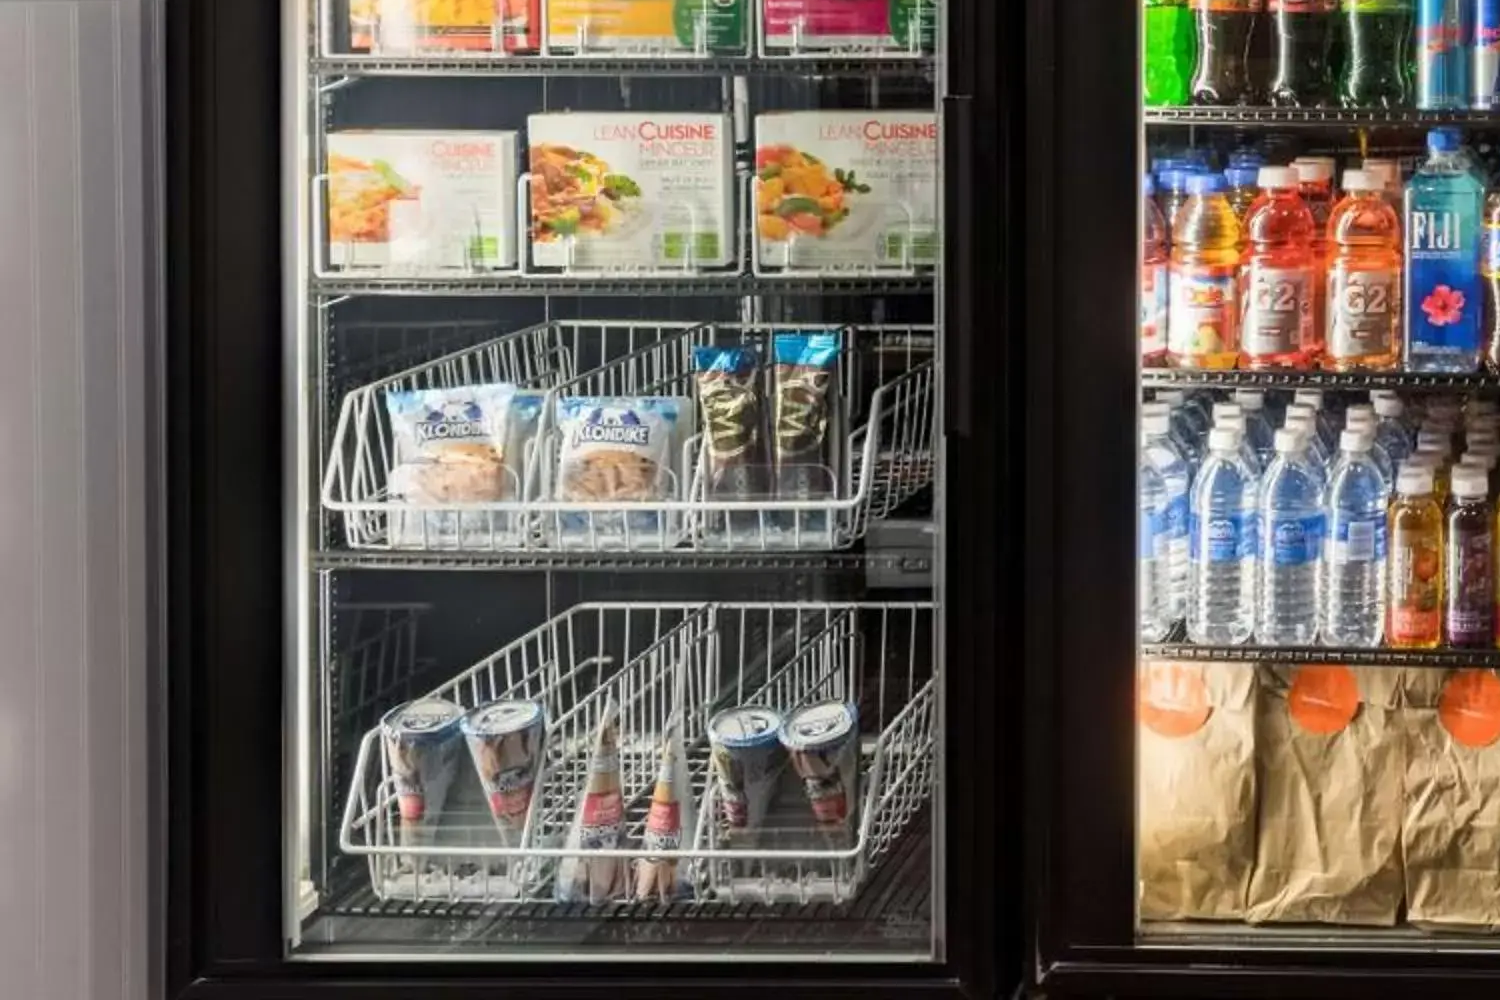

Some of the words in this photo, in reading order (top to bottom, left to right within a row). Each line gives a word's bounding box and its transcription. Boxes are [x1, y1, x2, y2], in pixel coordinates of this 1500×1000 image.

[638, 121, 715, 140] CUISINE
[1411, 211, 1462, 250] FIJI
[577, 426, 639, 443] KLONDIKE
